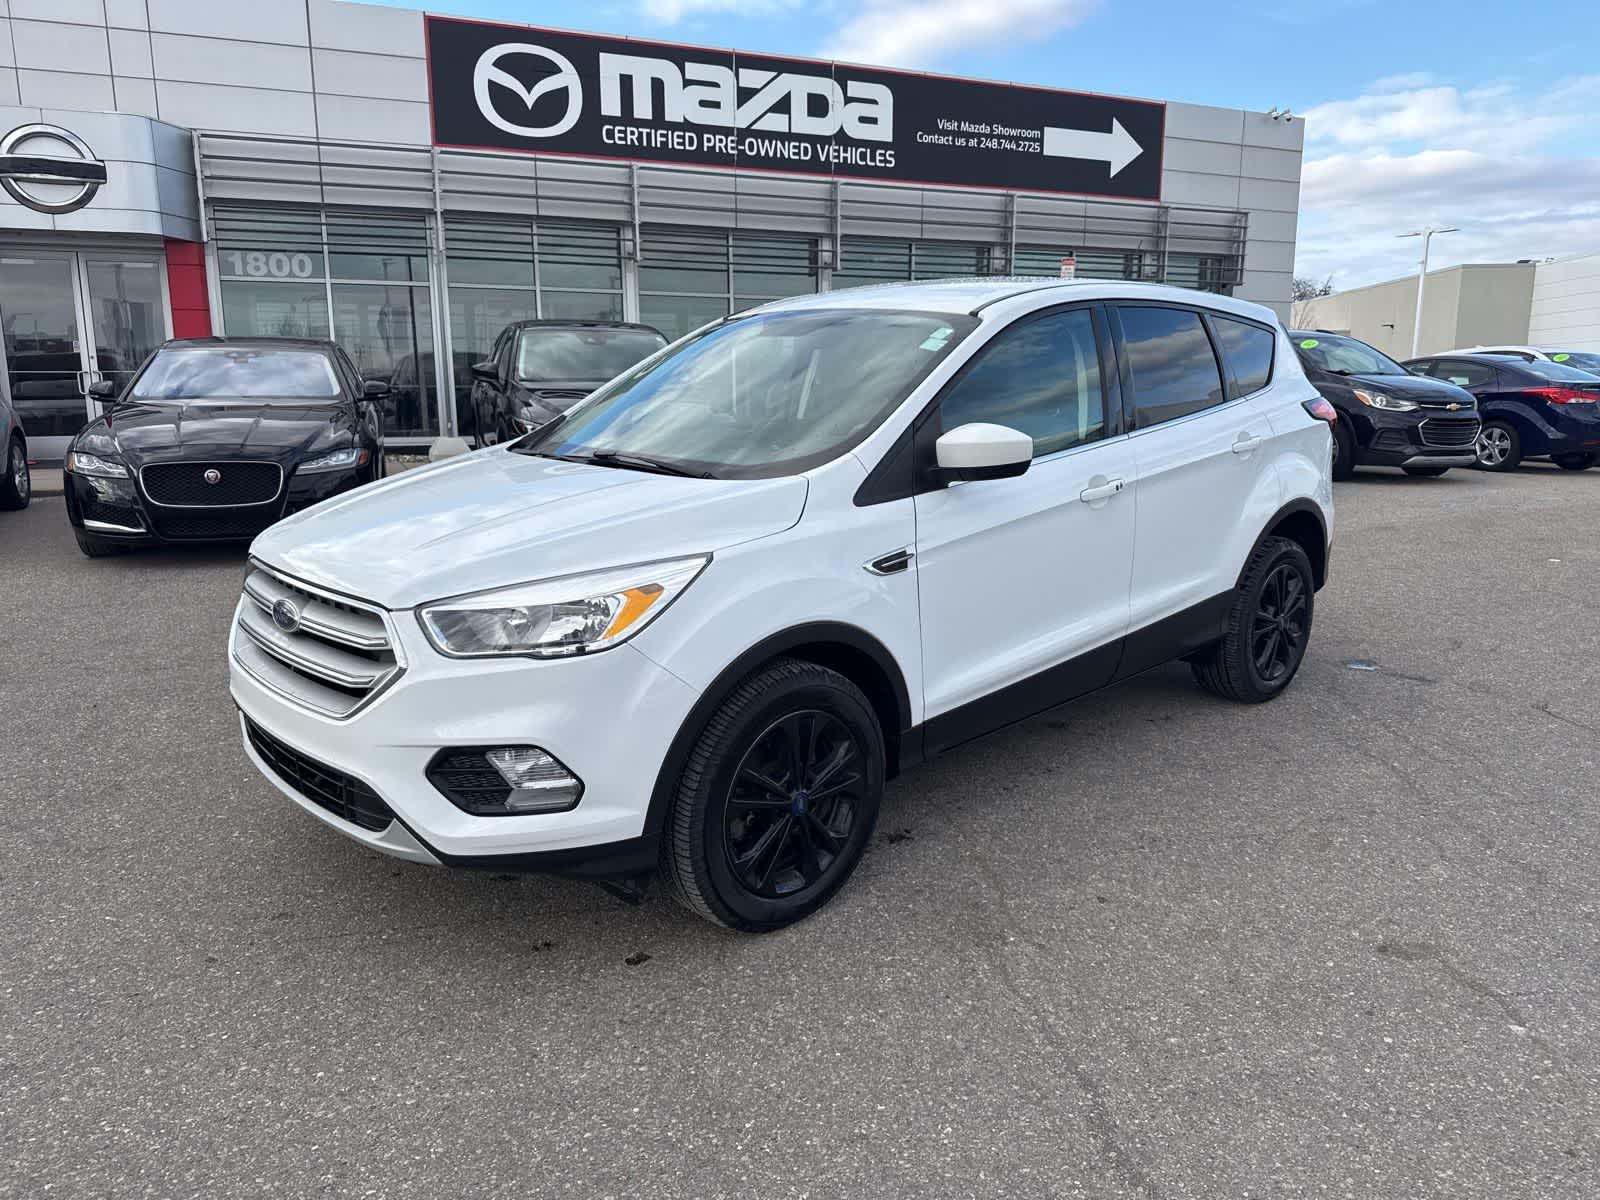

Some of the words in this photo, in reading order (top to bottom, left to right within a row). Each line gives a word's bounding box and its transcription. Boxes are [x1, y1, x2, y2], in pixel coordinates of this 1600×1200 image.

[937, 118, 958, 131] Visit
[960, 121, 990, 134] Mazda
[992, 124, 1040, 138] Showroom
[602, 125, 697, 151] CERTIFIED
[703, 133, 812, 161] PRE-OWNED
[816, 144, 895, 168] VEHICLES
[916, 132, 952, 145] Contact
[955, 137, 966, 146] us
[968, 138, 978, 147] at
[980, 138, 1040, 152] 248.744.2725
[227, 251, 313, 278] 1800
